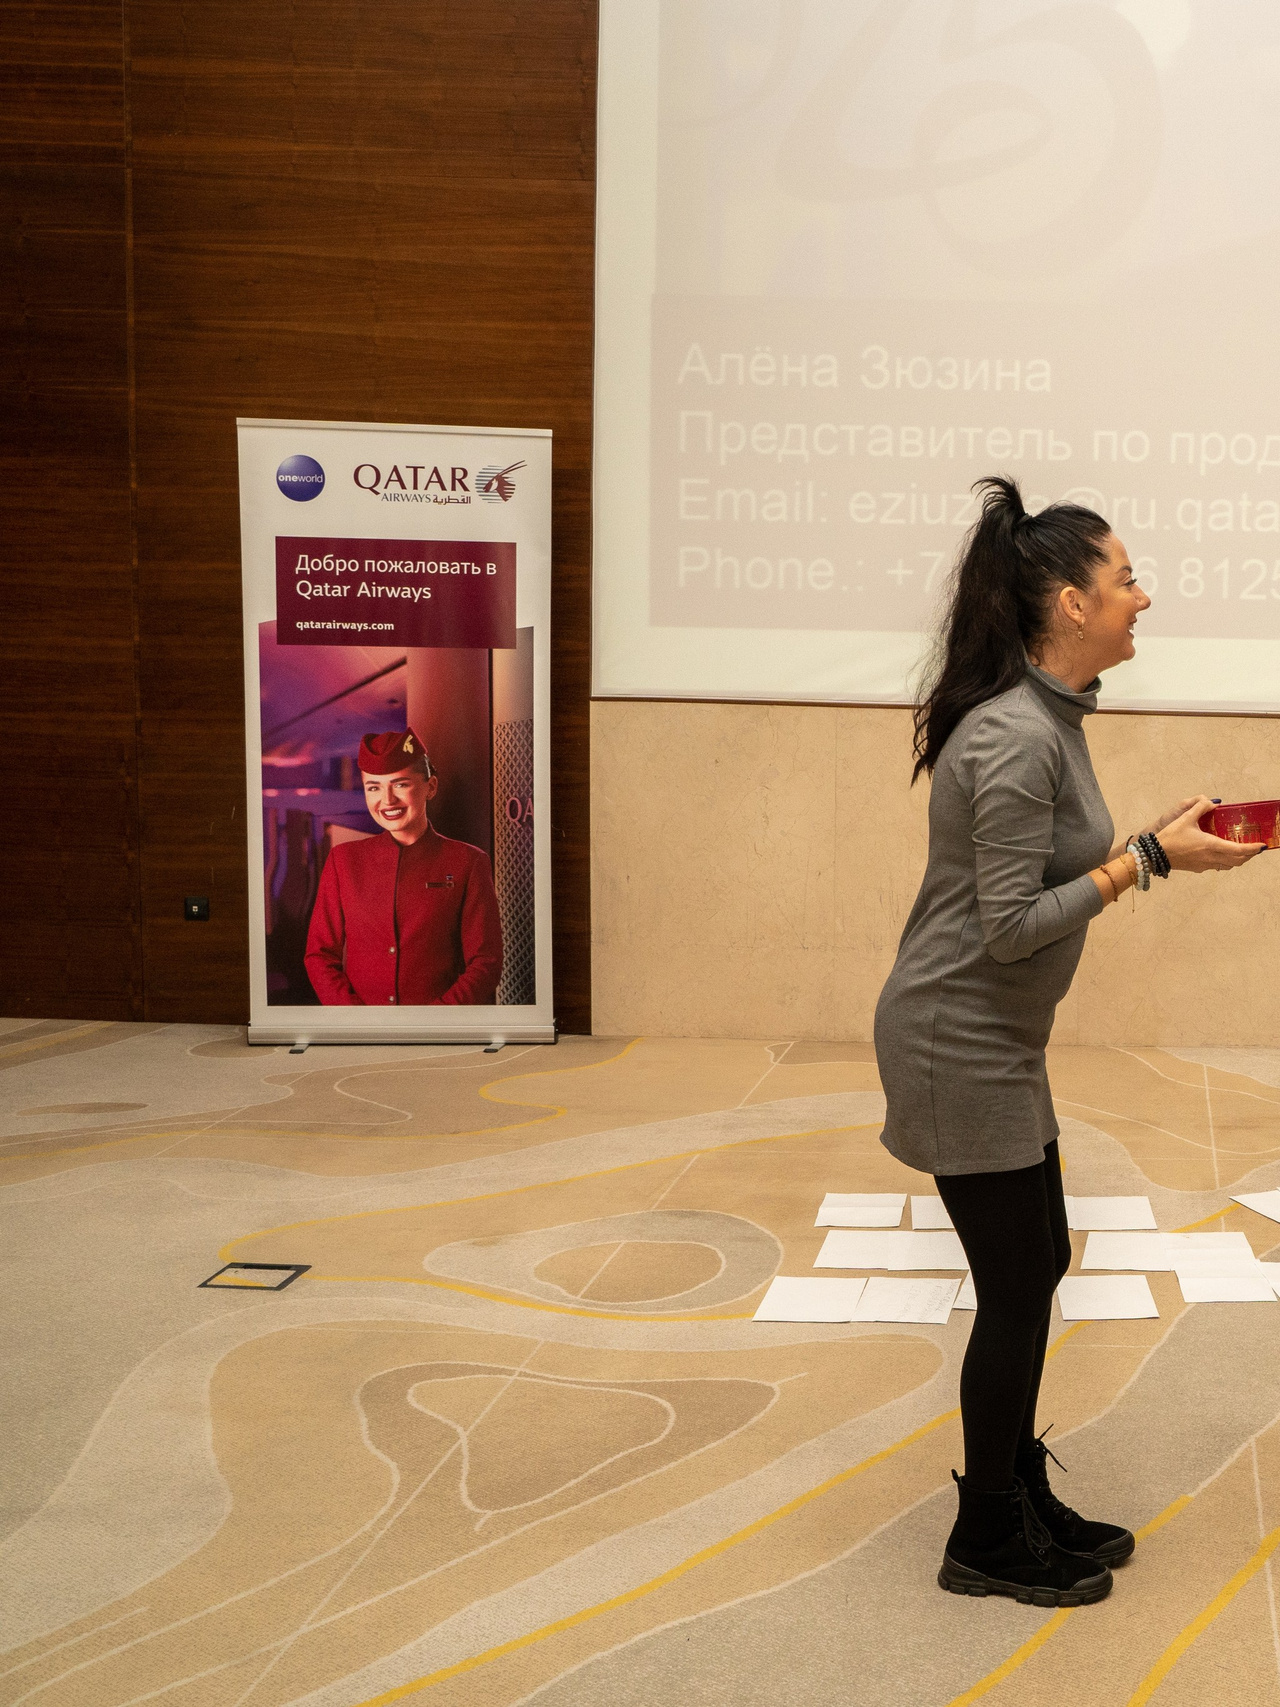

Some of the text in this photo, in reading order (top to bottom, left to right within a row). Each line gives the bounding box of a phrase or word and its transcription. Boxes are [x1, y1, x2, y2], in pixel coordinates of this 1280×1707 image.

[677, 341, 1053, 393] Алёна Зюзина
[678, 409, 1073, 466] Представитель
[1093, 429, 1151, 463] по
[278, 472, 324, 484] oneworld
[353, 463, 471, 496] QATAR
[380, 493, 432, 504] AIRWAYS
[678, 477, 828, 524] Email:
[295, 553, 498, 576] Добро пожаловать в
[678, 546, 865, 591] Phone.:
[296, 580, 432, 603] Qatar Airways
[295, 620, 395, 632] qatarairways.com
